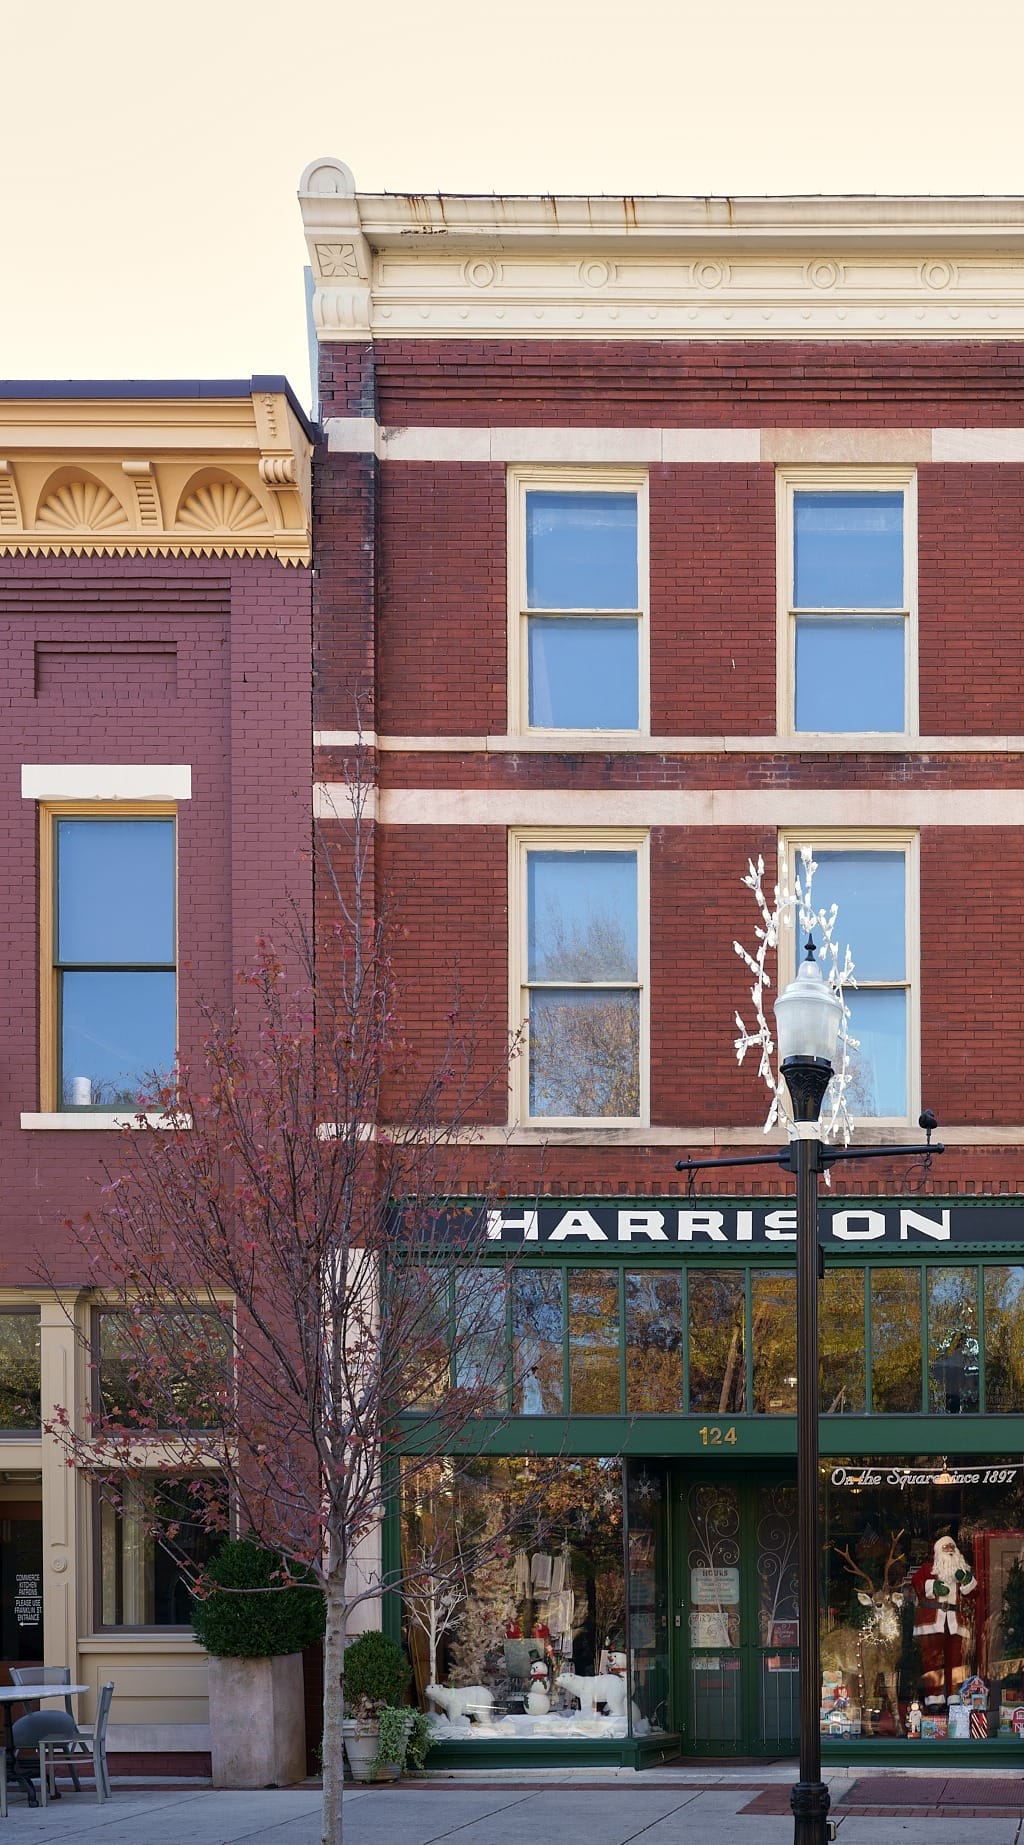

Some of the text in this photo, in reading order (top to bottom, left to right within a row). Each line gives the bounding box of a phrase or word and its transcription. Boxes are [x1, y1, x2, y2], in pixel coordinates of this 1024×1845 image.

[487, 1210, 951, 1240] HARRISON
[700, 1427, 737, 1445] 124
[831, 1468, 853, 1486] On
[857, 1468, 882, 1485] the
[943, 1470, 980, 1484] ince
[982, 1470, 1017, 1484] 1897
